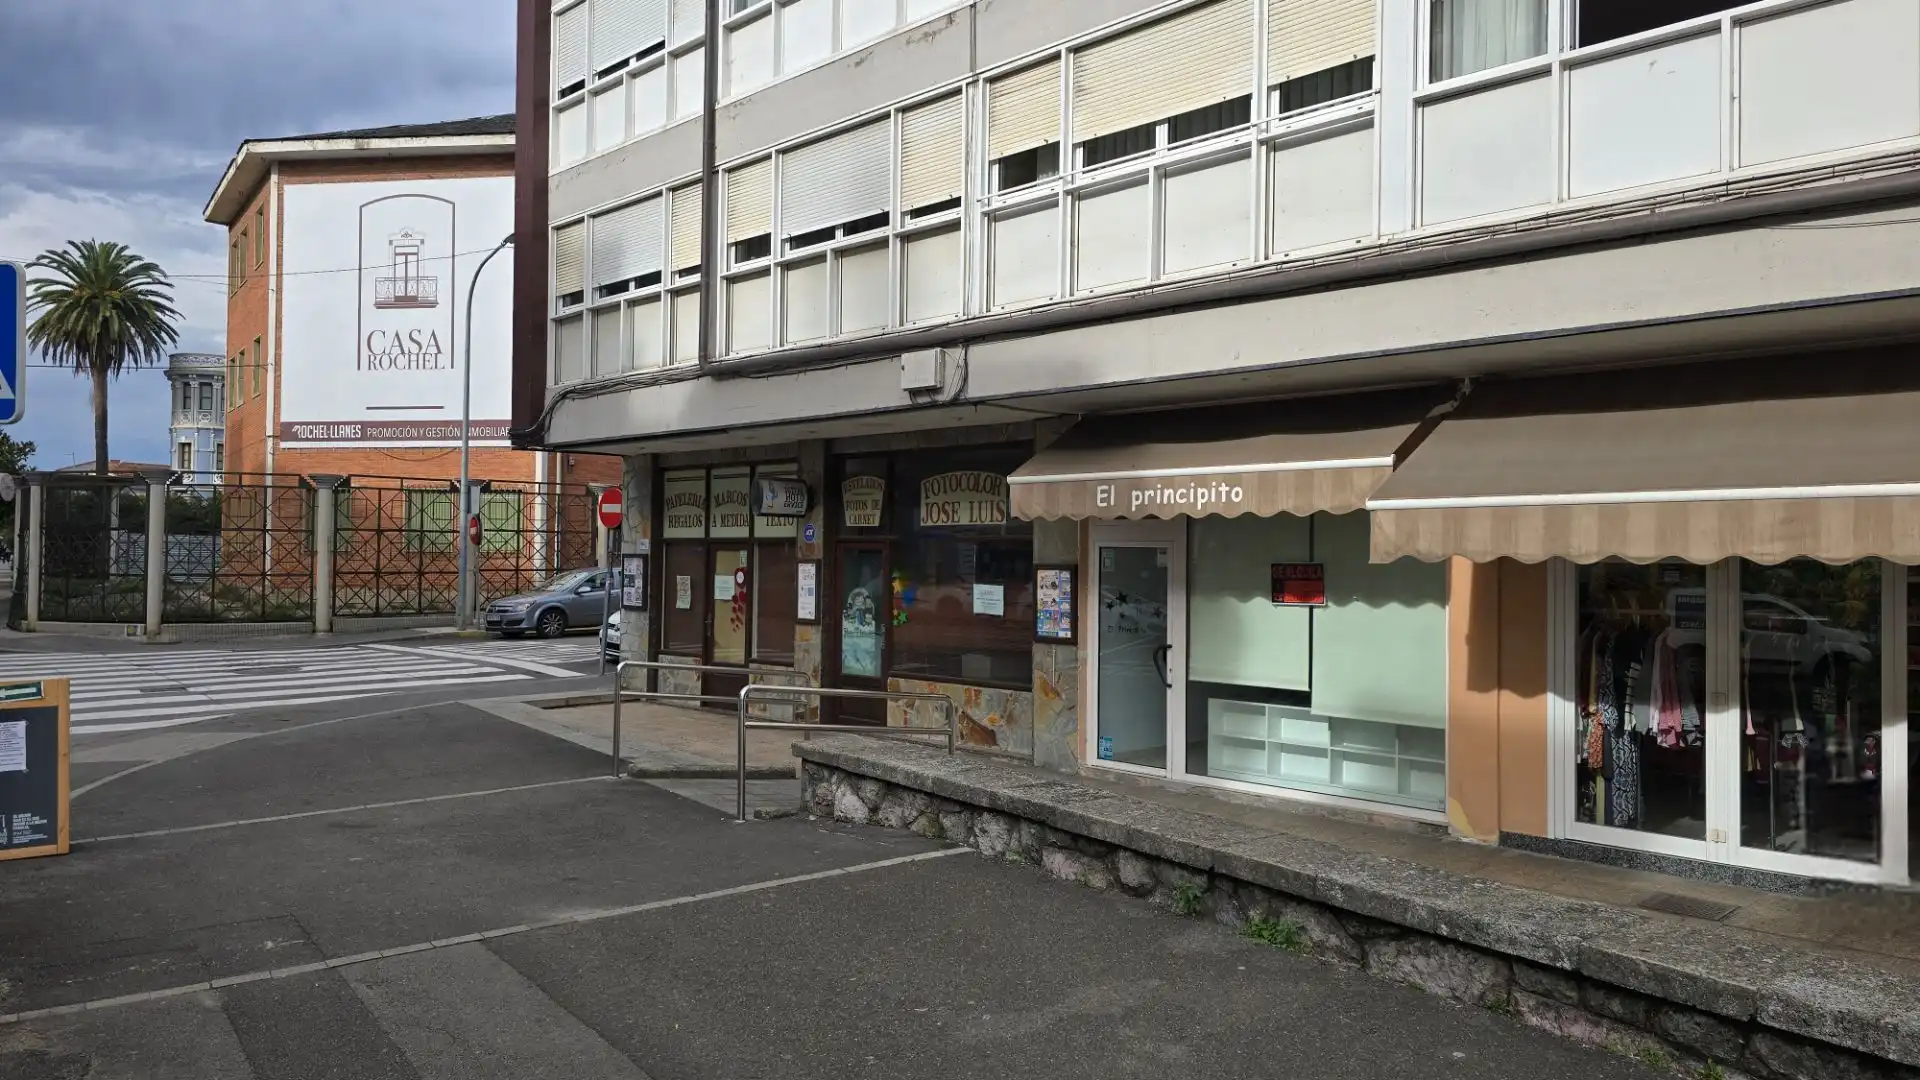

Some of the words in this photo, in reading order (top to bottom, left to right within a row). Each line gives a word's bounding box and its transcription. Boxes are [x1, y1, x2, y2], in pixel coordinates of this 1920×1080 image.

[367, 328, 442, 356] CASA
[367, 353, 446, 371] ROCHEL
[367, 426, 418, 438] PROMOCIÓN
[420, 427, 425, 437] Y
[425, 425, 460, 438] GESTIÓN
[922, 472, 1003, 500] FOTOCOLOR
[714, 489, 749, 508] MARCOS
[1096, 484, 1115, 507] El
[1131, 482, 1243, 512] principito
[668, 513, 703, 529] REGALOS
[712, 513, 717, 528] A
[720, 512, 751, 528] MEDIDA
[765, 514, 795, 527] TEXTO
[849, 512, 877, 525] CARNET
[922, 501, 961, 524] JOSE
[968, 500, 1006, 523] LUIS
